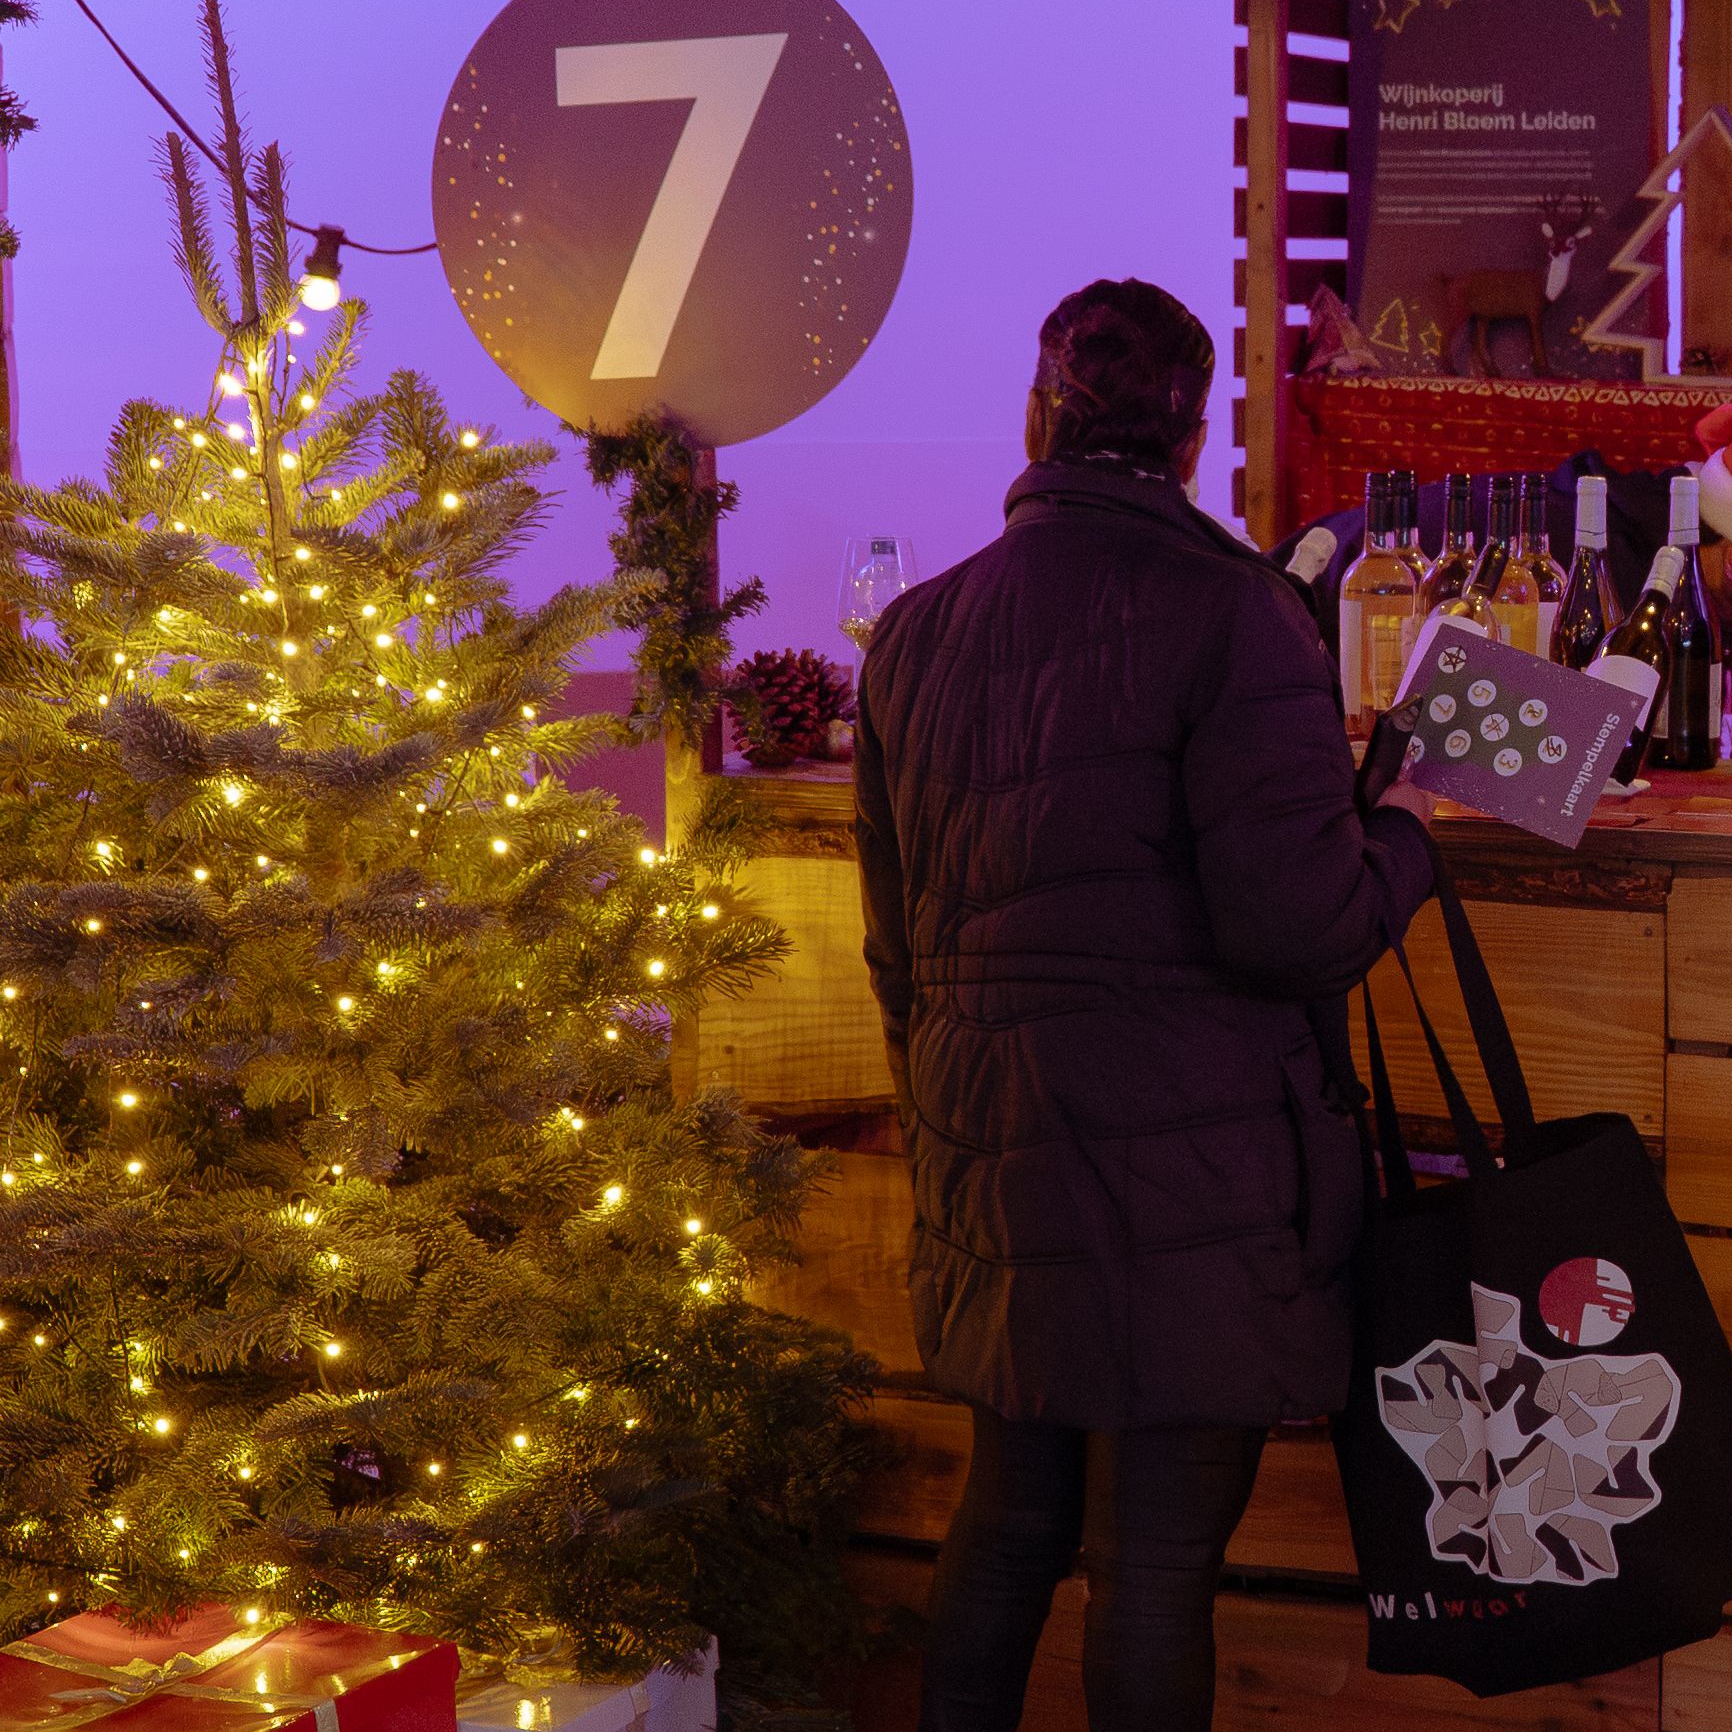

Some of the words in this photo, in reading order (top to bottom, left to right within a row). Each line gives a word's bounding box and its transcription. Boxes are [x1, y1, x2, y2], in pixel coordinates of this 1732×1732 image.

[1378, 83, 1504, 108] Wijnkoperij
[1378, 111, 1438, 131] Henri
[1521, 111, 1596, 131] Leiden
[555, 33, 789, 380] 7
[1560, 713, 1621, 817] Stempelkaart
